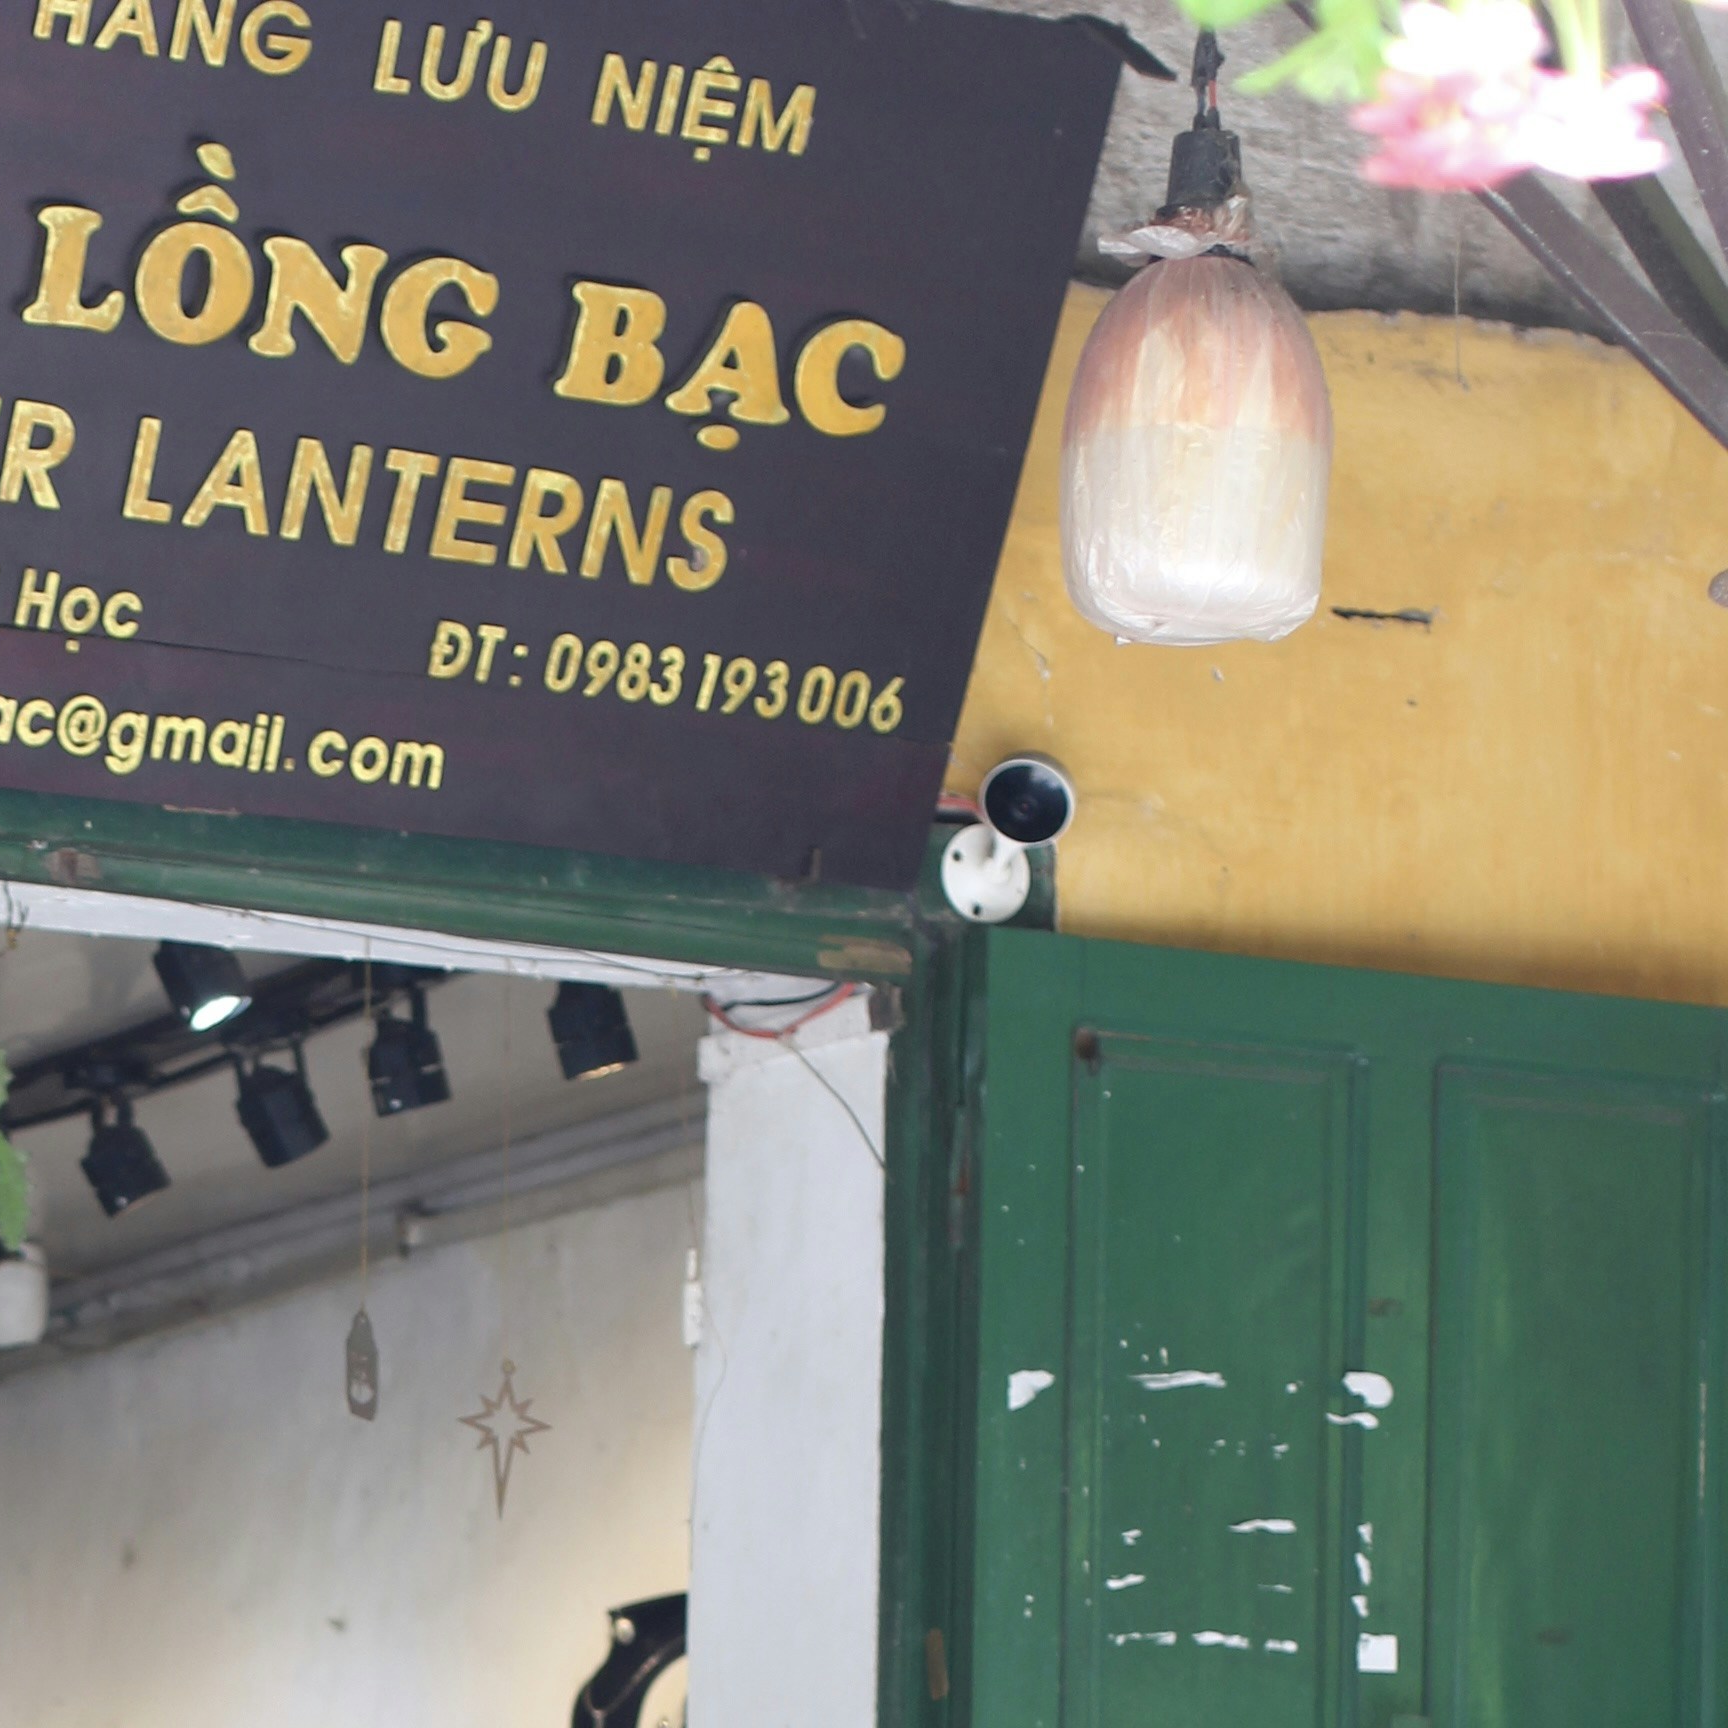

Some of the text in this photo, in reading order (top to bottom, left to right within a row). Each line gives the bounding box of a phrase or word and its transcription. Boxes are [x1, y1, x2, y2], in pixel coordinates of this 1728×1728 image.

[374, 19, 548, 113] LƯU
[591, 53, 817, 162] NIỆM
[22, 143, 500, 380] LỒNG
[553, 281, 906, 451] BẠC
[122, 417, 735, 592] LANTERNS
[14, 567, 143, 653] Học
